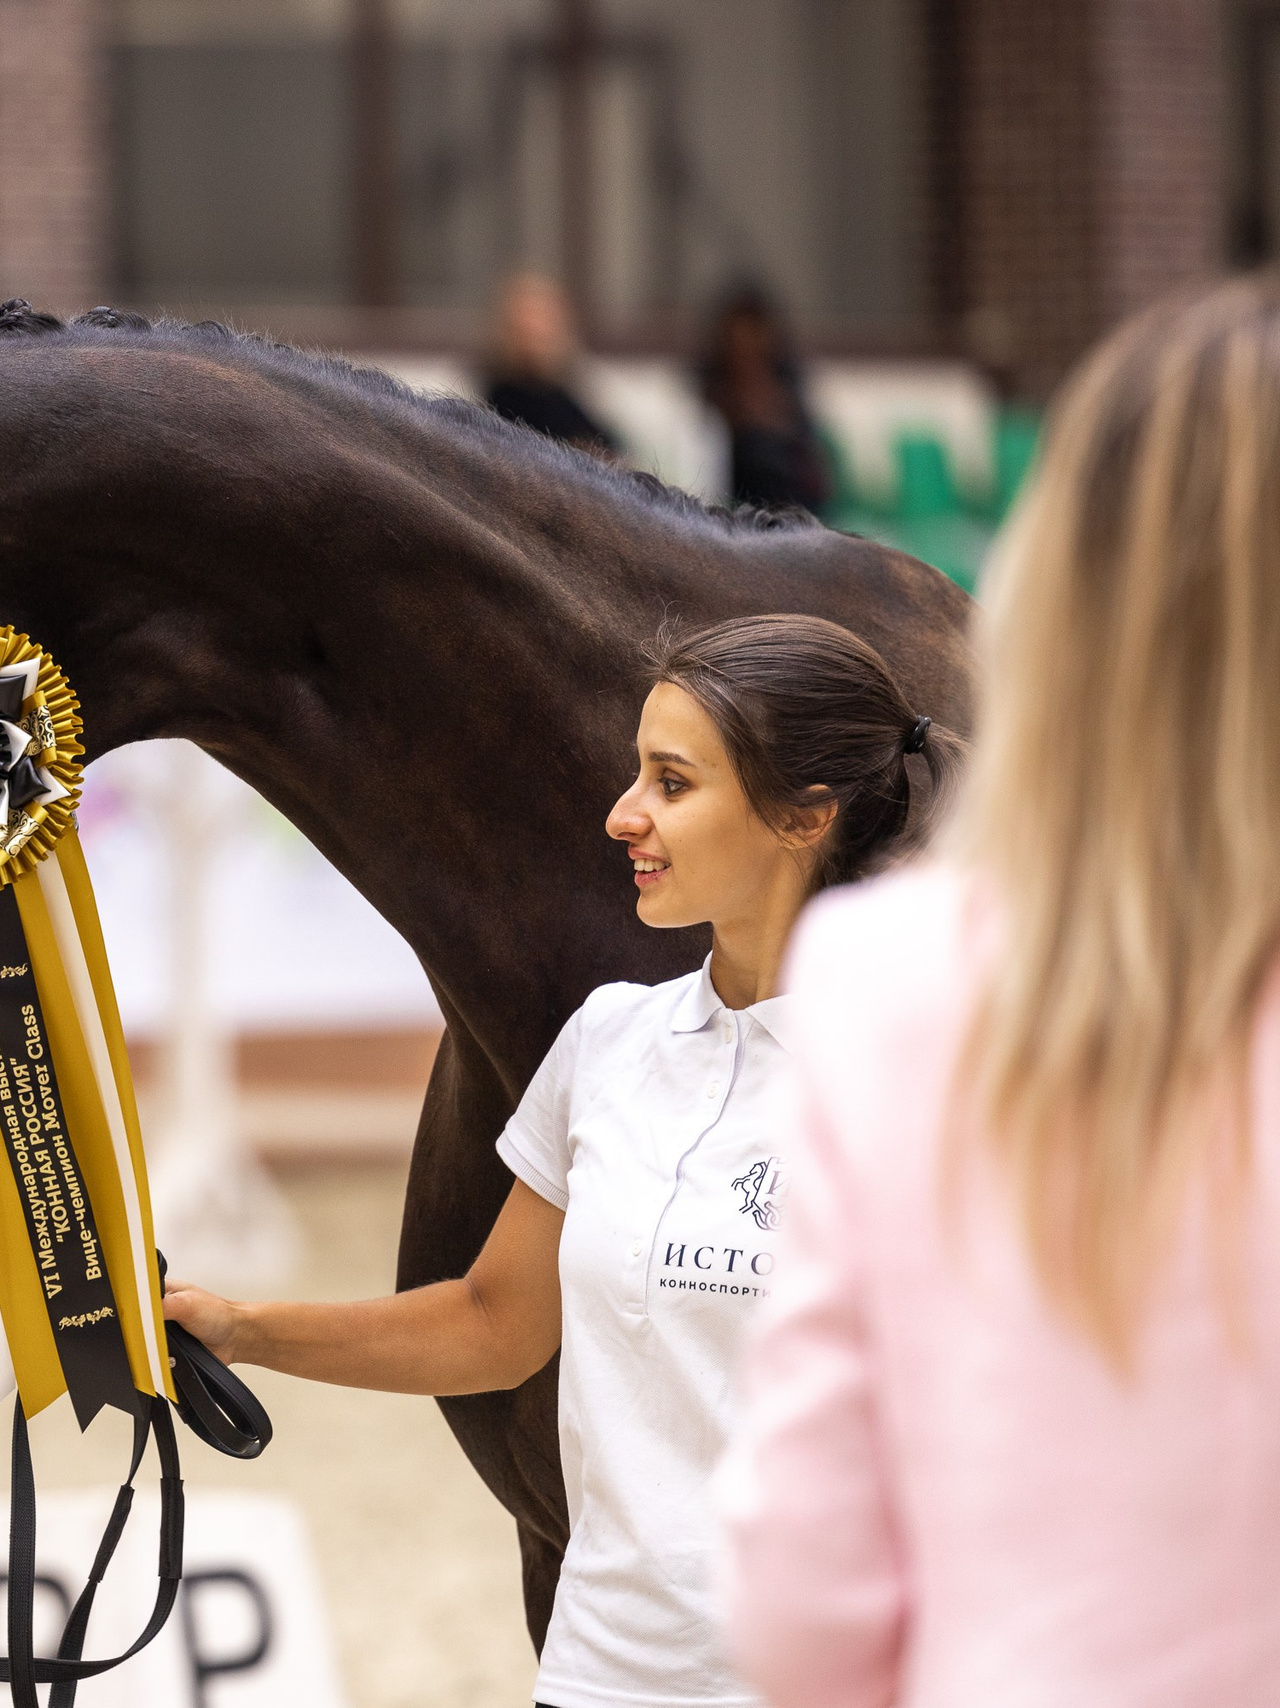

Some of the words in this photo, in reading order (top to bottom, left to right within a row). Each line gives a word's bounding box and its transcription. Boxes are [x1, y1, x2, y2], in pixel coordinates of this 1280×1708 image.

[21, 1004, 43, 1059] Class
[10, 1058, 44, 1147] РОССИЯ"
[38, 1065, 61, 1130] Mover
[3, 1105, 56, 1269] Международная
[37, 1151, 70, 1243] "КОННАЯ
[51, 1135, 101, 1281] Вице-чемпион
[47, 1272, 64, 1298] VI
[659, 1278, 771, 1298] КОННОСПОРТИ
[664, 1242, 774, 1276] ИСТО
